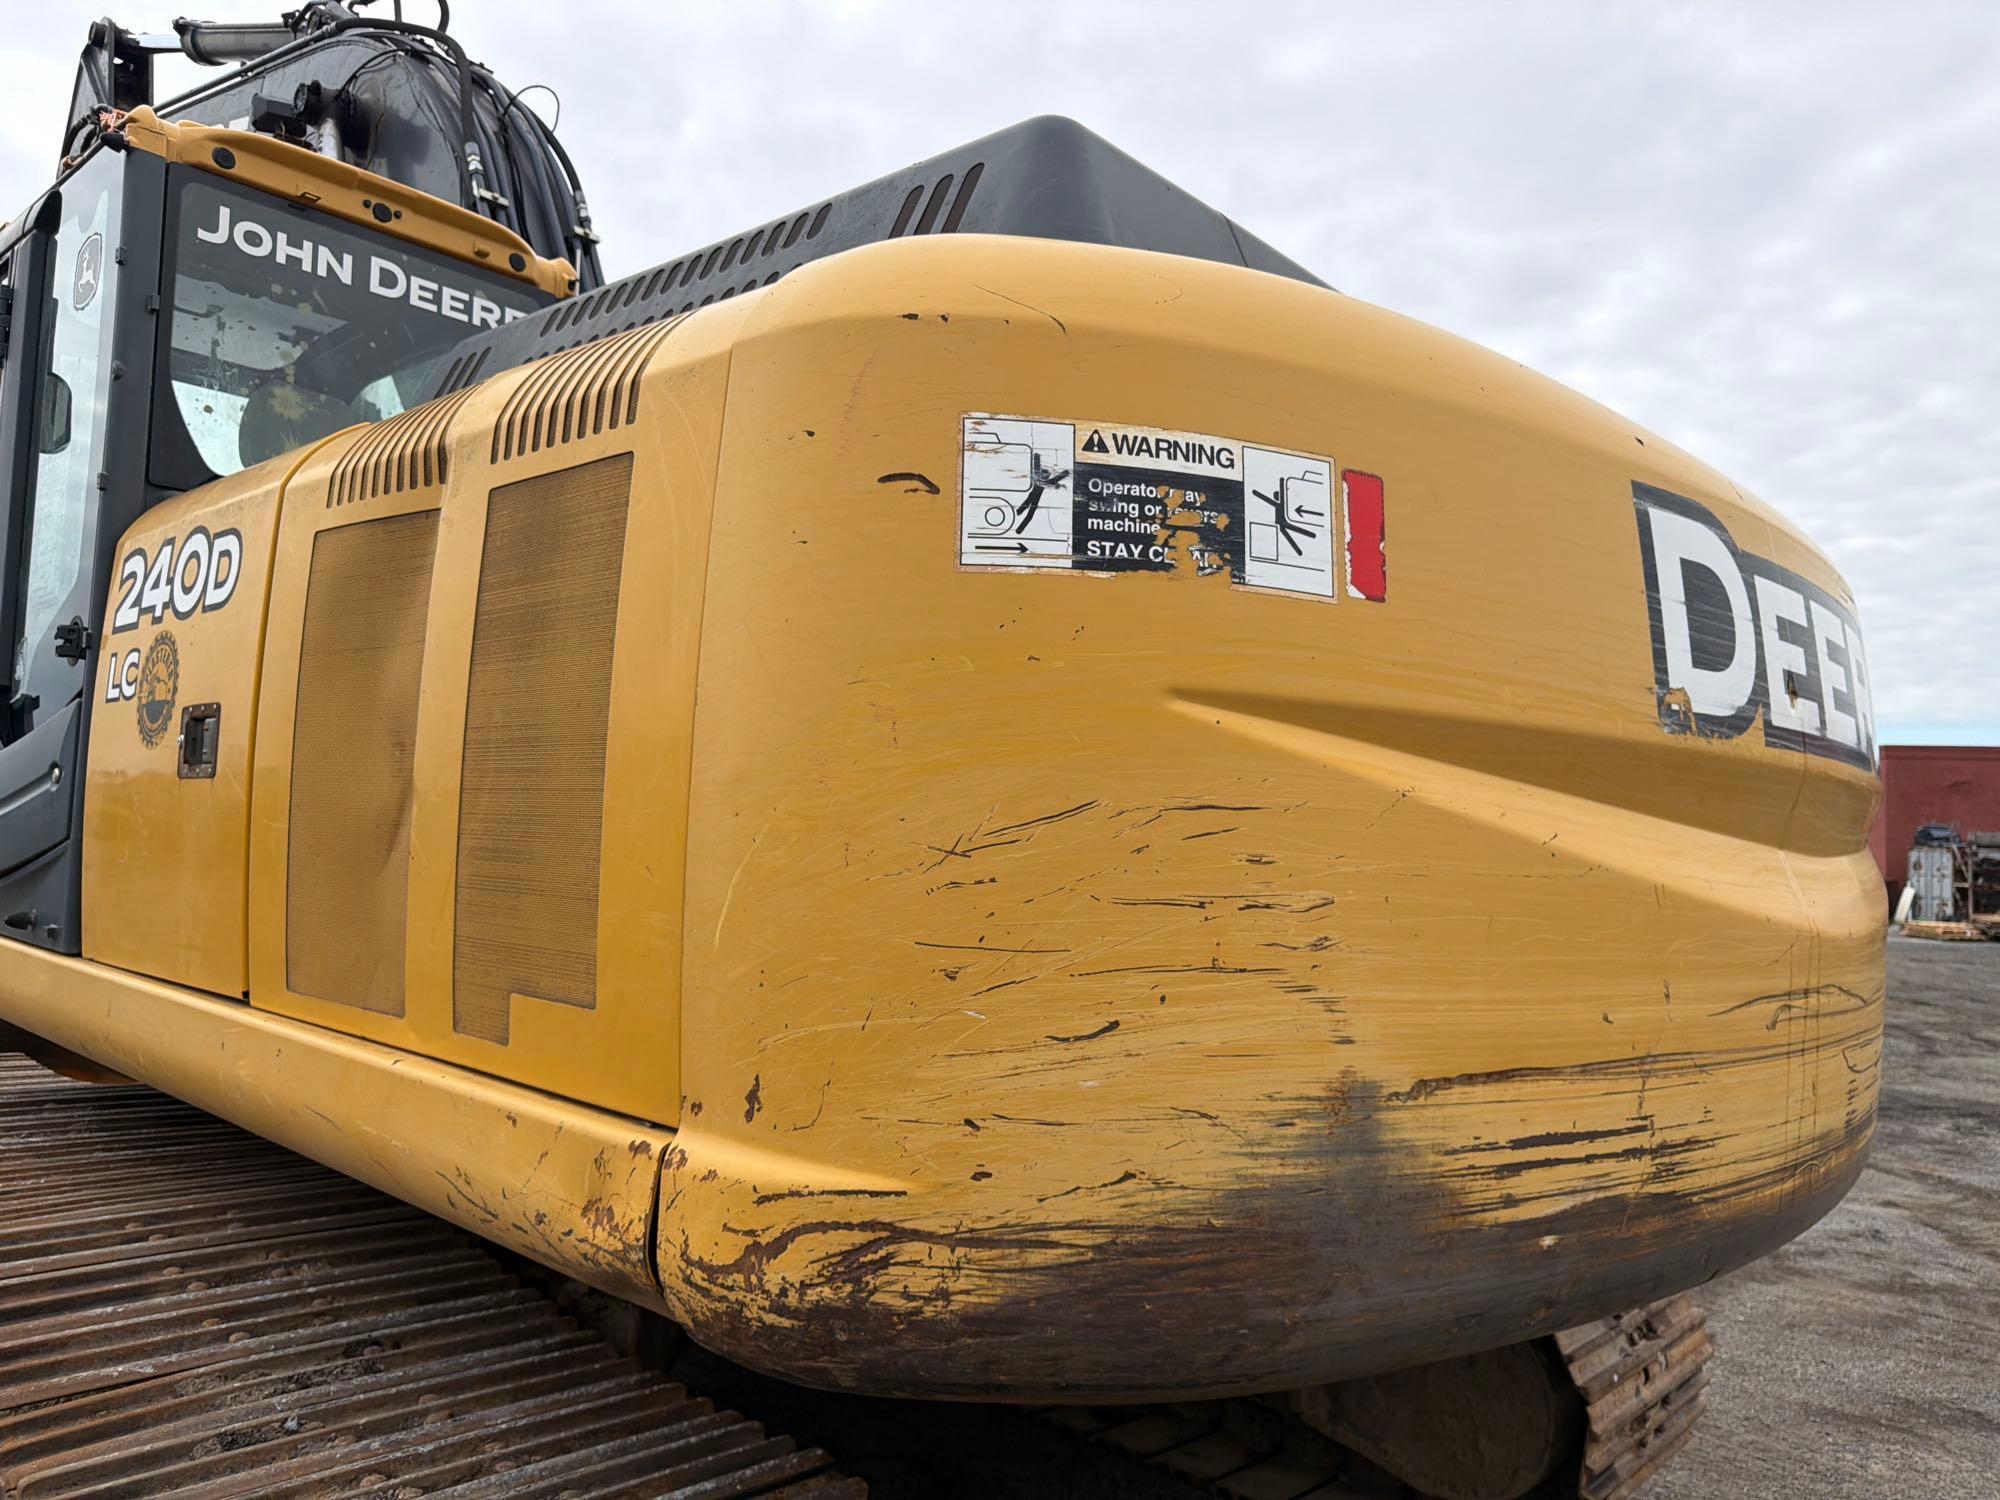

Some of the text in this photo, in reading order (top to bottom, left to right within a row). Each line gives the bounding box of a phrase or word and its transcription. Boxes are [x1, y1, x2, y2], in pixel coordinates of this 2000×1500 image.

[197, 205, 353, 286] JOHN
[1111, 433, 1235, 470] WARNING
[1088, 478, 1162, 499] Operato
[1144, 503, 1162, 516] or
[1087, 518, 1162, 534] machine
[1087, 540, 1144, 559] STAY
[112, 526, 243, 635] 240D
[105, 647, 142, 704] LC
